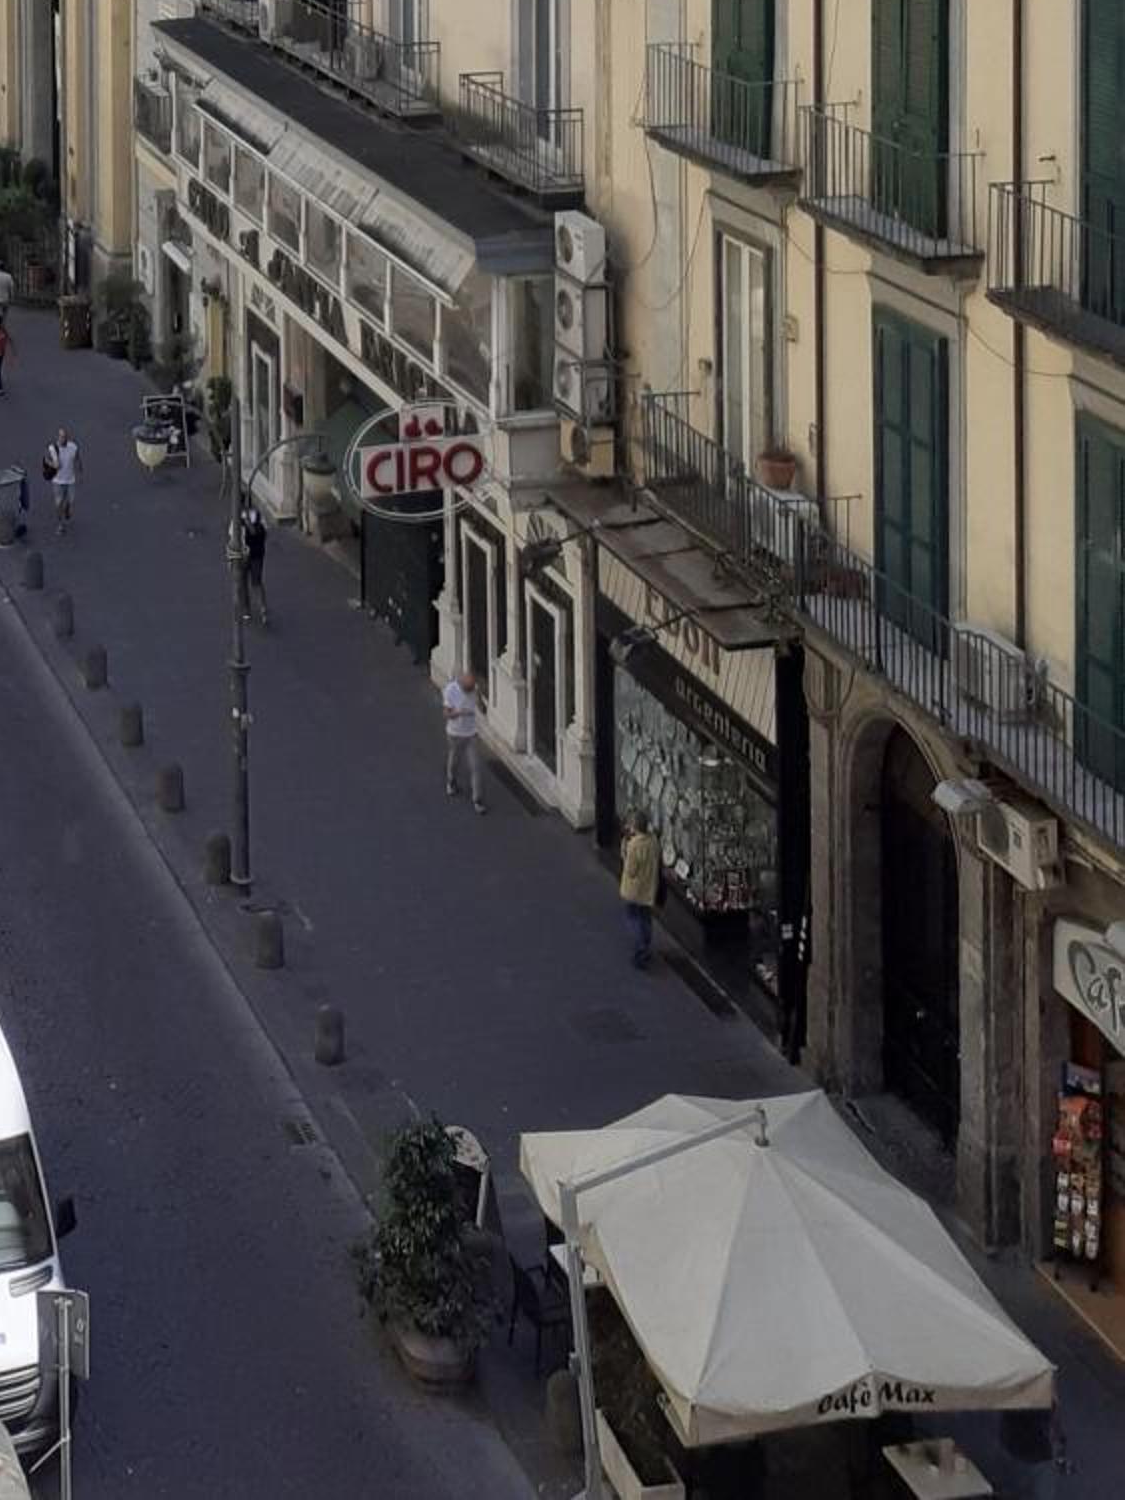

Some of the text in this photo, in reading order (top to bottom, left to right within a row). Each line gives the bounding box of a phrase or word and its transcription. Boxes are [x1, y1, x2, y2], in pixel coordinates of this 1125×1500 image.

[404, 414, 444, 438] da
[366, 441, 484, 494] CIRO
[1067, 938, 1125, 1036] Caf
[877, 1380, 935, 1405] Max
